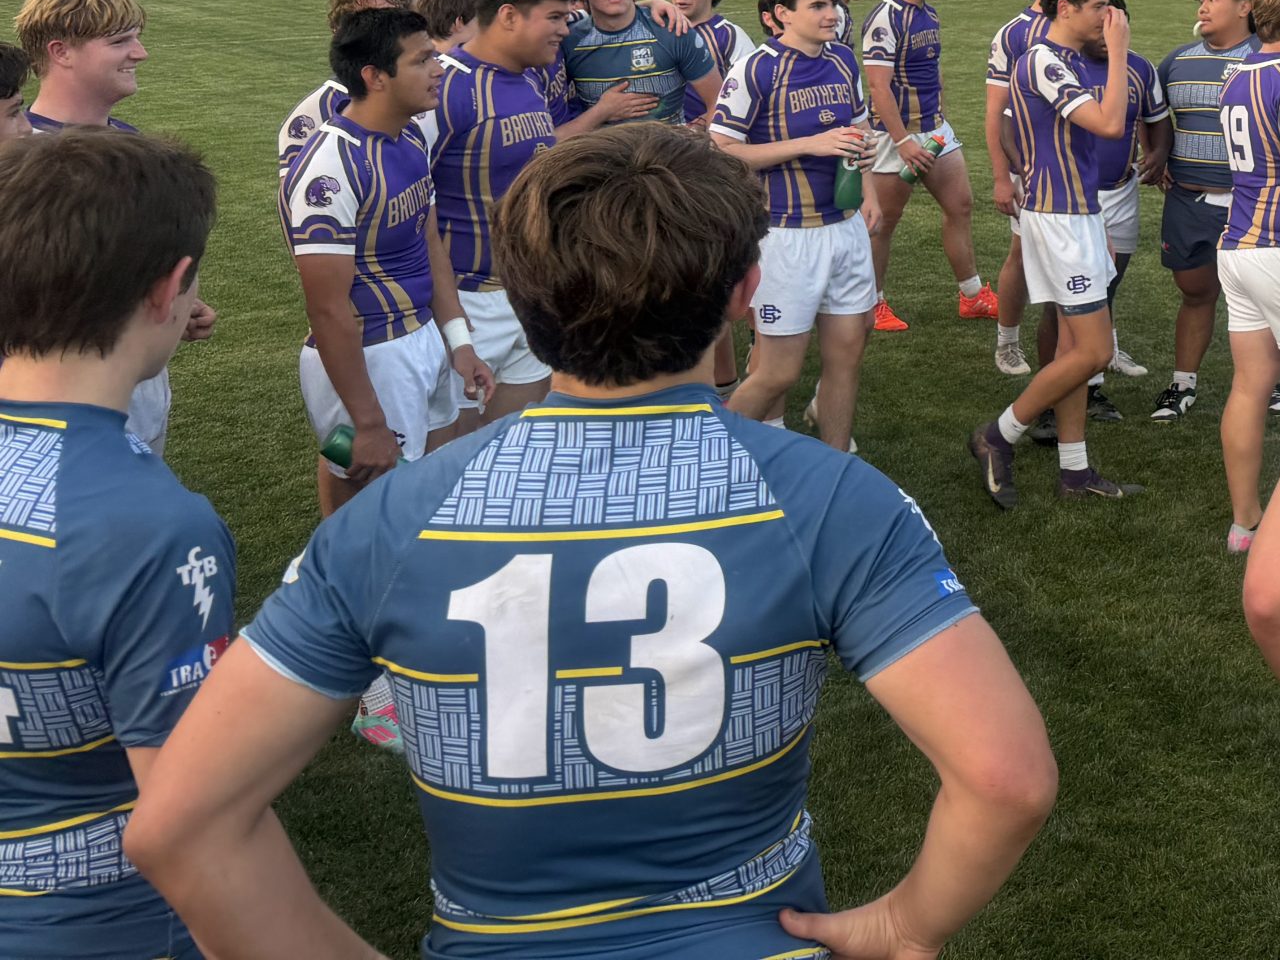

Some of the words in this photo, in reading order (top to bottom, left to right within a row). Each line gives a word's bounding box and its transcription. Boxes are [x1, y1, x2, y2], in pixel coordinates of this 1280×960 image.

[789, 84, 850, 113] BROTHERS
[1220, 105, 1255, 173] 19
[446, 542, 726, 778] 13
